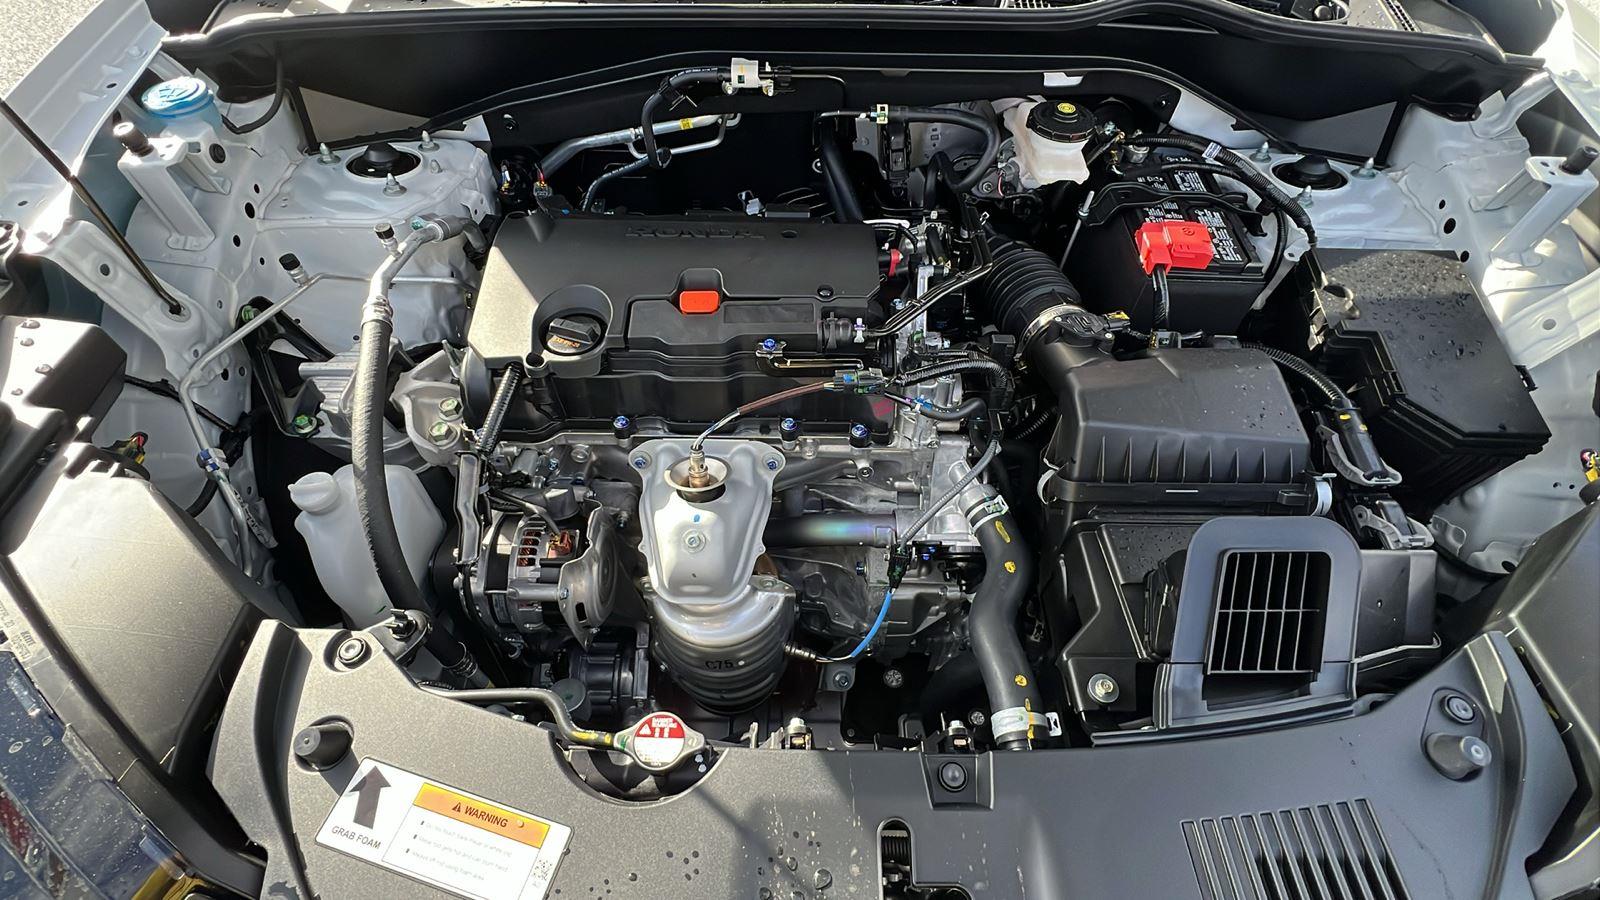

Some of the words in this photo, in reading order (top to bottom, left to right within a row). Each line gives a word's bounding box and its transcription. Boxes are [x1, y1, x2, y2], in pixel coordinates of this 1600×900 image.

[464, 805, 509, 828] WARNING
[331, 825, 356, 840] GRAB
[356, 834, 382, 850] FOAM
